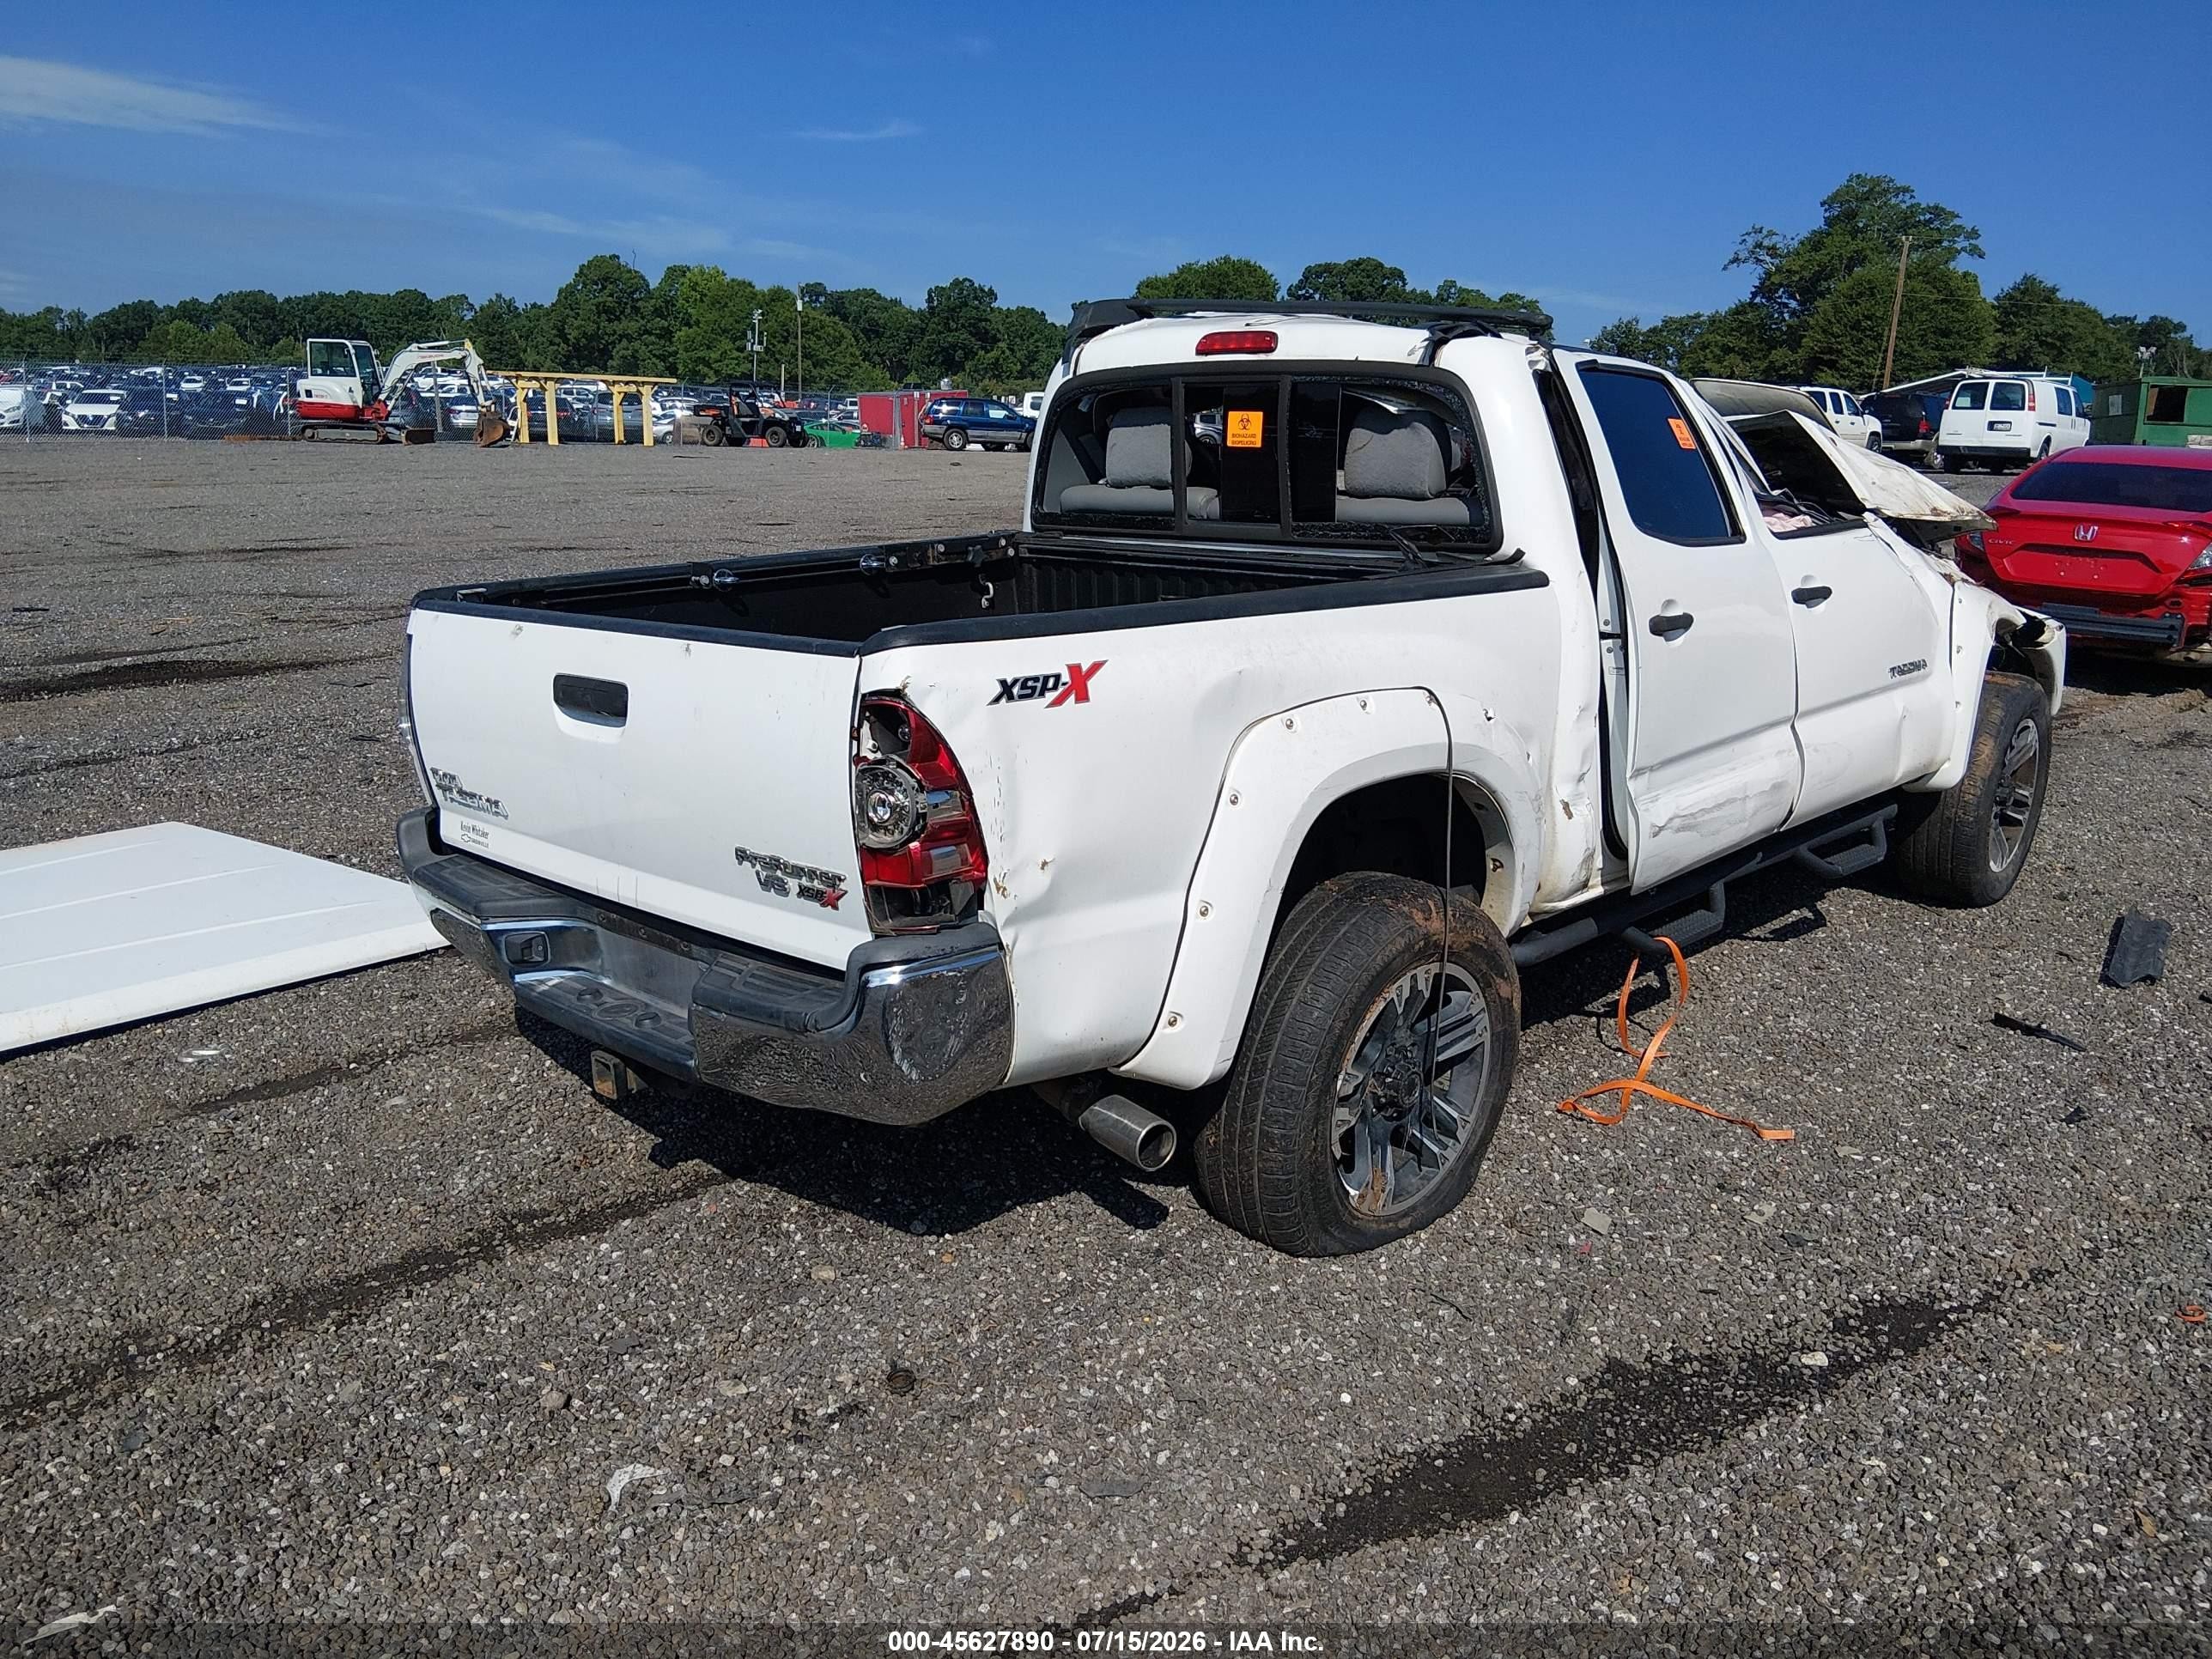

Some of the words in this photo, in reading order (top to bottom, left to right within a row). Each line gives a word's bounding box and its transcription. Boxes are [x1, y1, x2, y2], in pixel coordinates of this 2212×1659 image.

[1888, 659, 1929, 679] TACOMA
[987, 659, 1109, 709] XSP-X
[755, 869, 791, 898] V6
